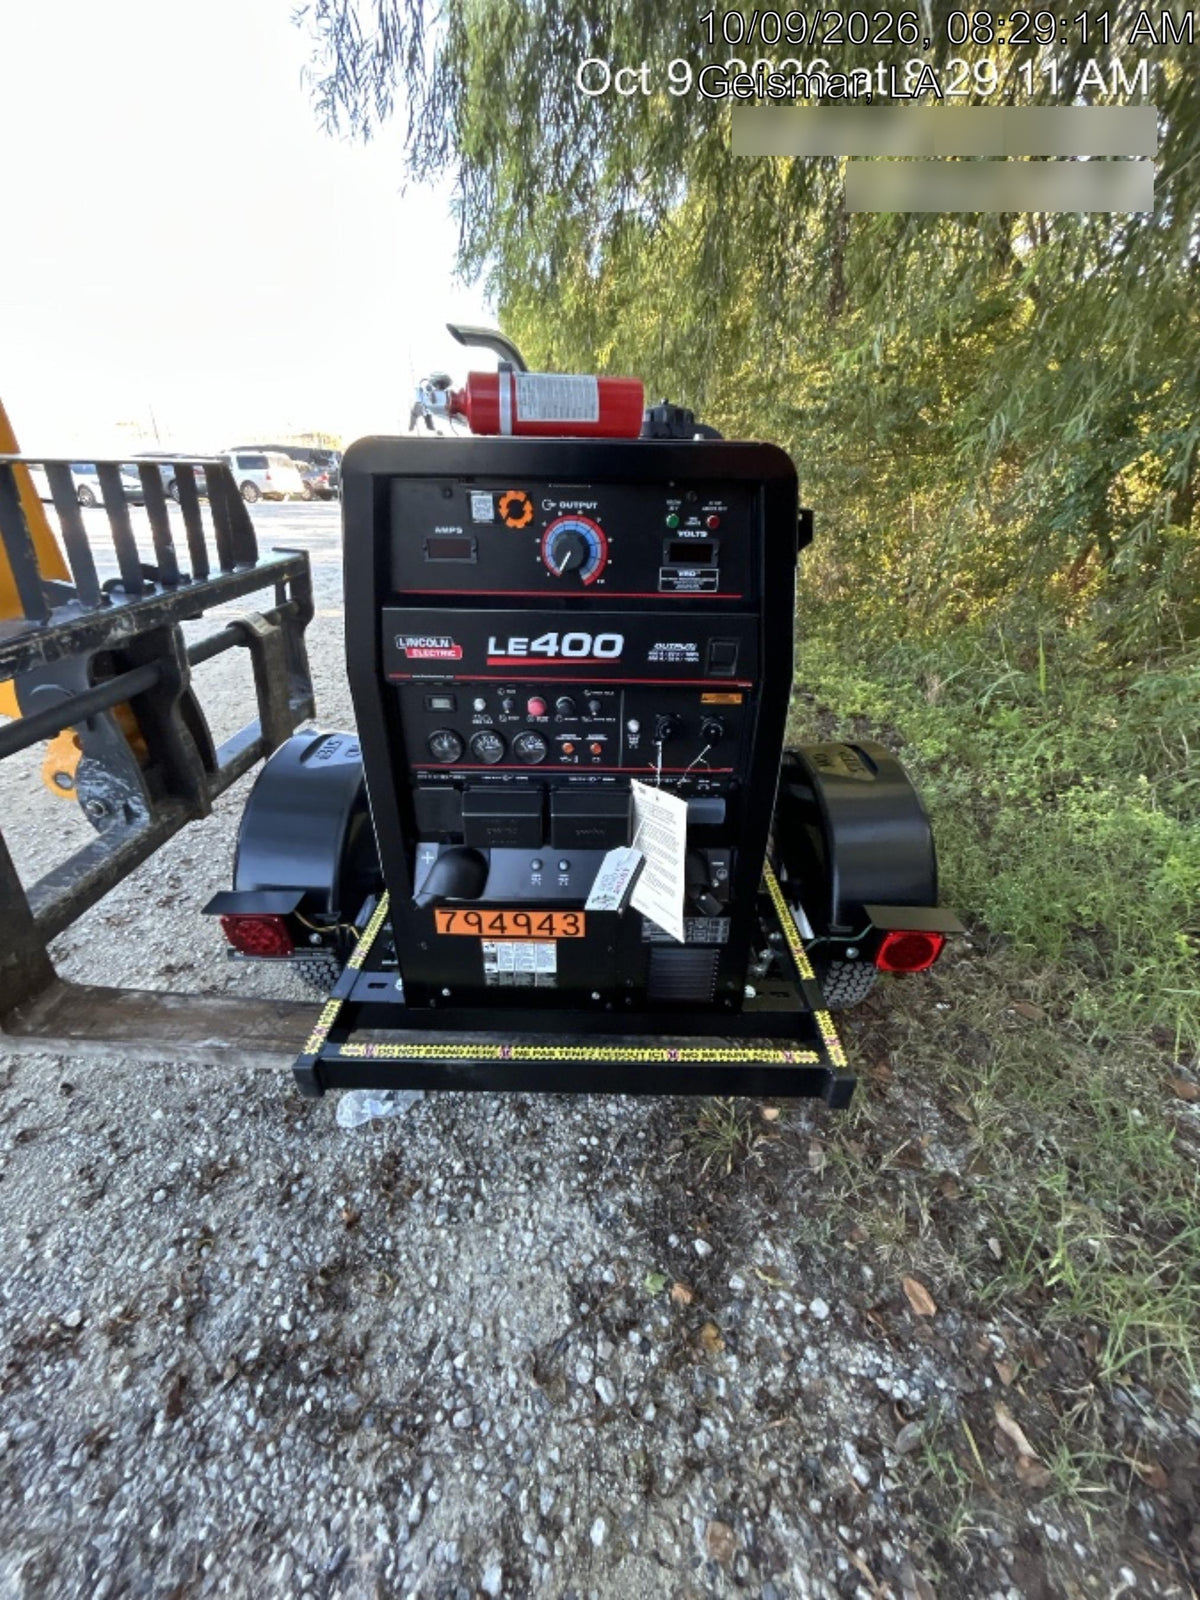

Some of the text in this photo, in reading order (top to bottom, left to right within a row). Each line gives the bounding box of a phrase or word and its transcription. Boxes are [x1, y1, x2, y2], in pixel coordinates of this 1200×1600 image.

[559, 501, 599, 510] OUTPUT
[435, 526, 463, 535] AMPS
[399, 637, 450, 648] LINCOLN
[487, 632, 625, 659] LE400
[411, 648, 457, 658] ELECTRIC
[438, 911, 581, 936] 794943
